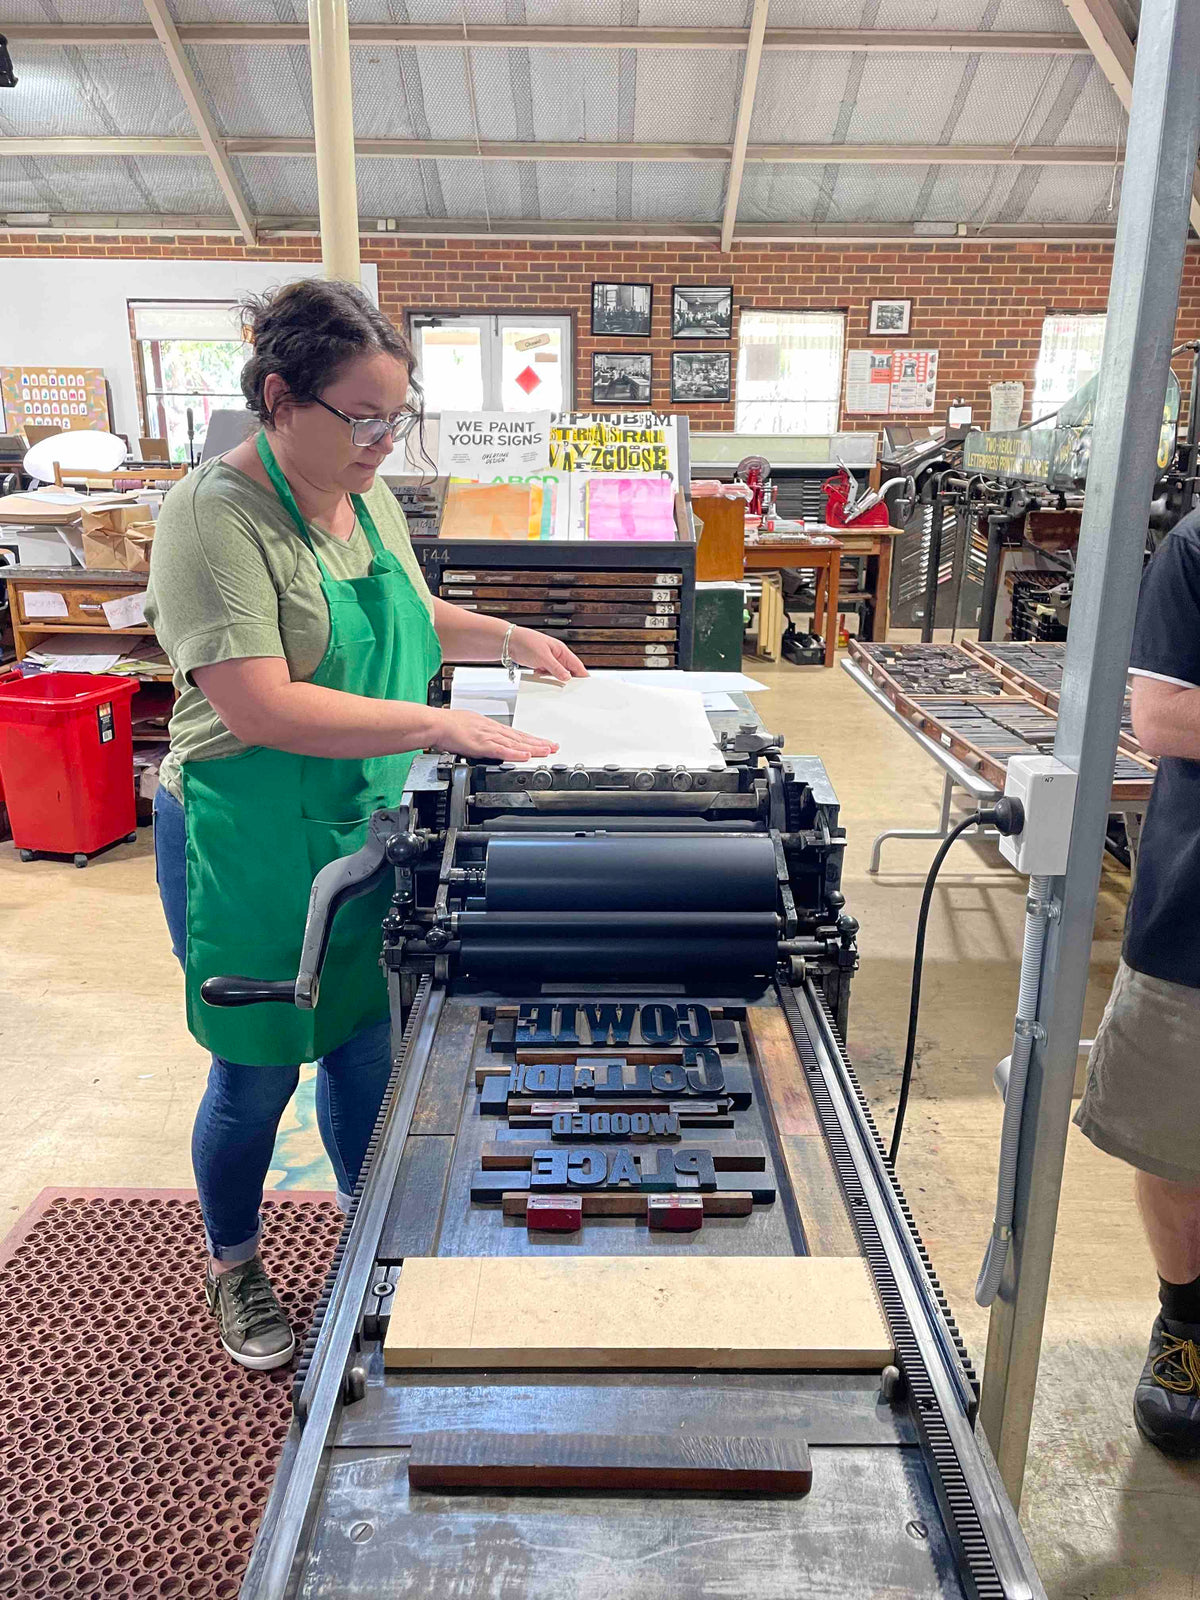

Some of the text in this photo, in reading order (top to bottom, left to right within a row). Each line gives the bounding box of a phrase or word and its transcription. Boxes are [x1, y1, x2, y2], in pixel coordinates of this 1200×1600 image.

[457, 421, 535, 433] WE PAINT
[448, 432, 543, 446] YOUR SIGNS
[422, 548, 450, 563] F44
[656, 591, 669, 600] 37
